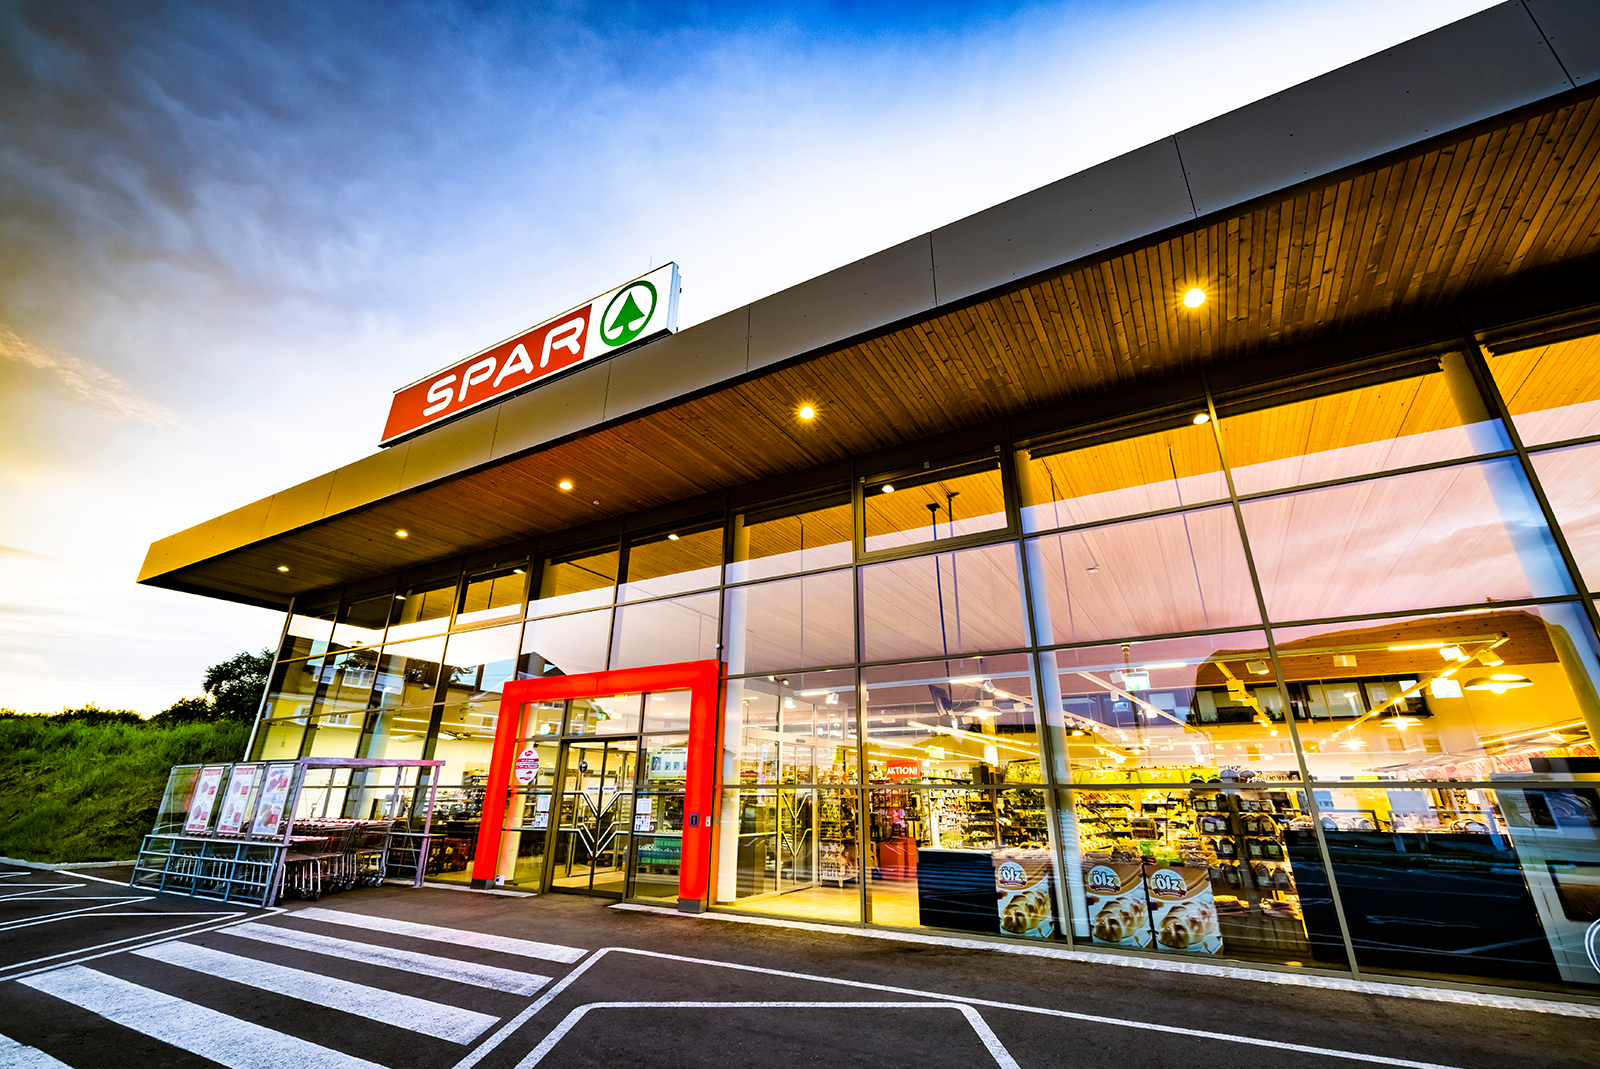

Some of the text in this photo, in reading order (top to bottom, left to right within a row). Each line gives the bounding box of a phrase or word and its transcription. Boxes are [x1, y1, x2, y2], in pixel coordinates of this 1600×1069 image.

[423, 317, 585, 416] SPAR
[887, 766, 918, 775] AKTION!
[1002, 866, 1022, 881] Ölz
[1092, 870, 1115, 887] Ölz
[1155, 874, 1181, 891] Ölz
